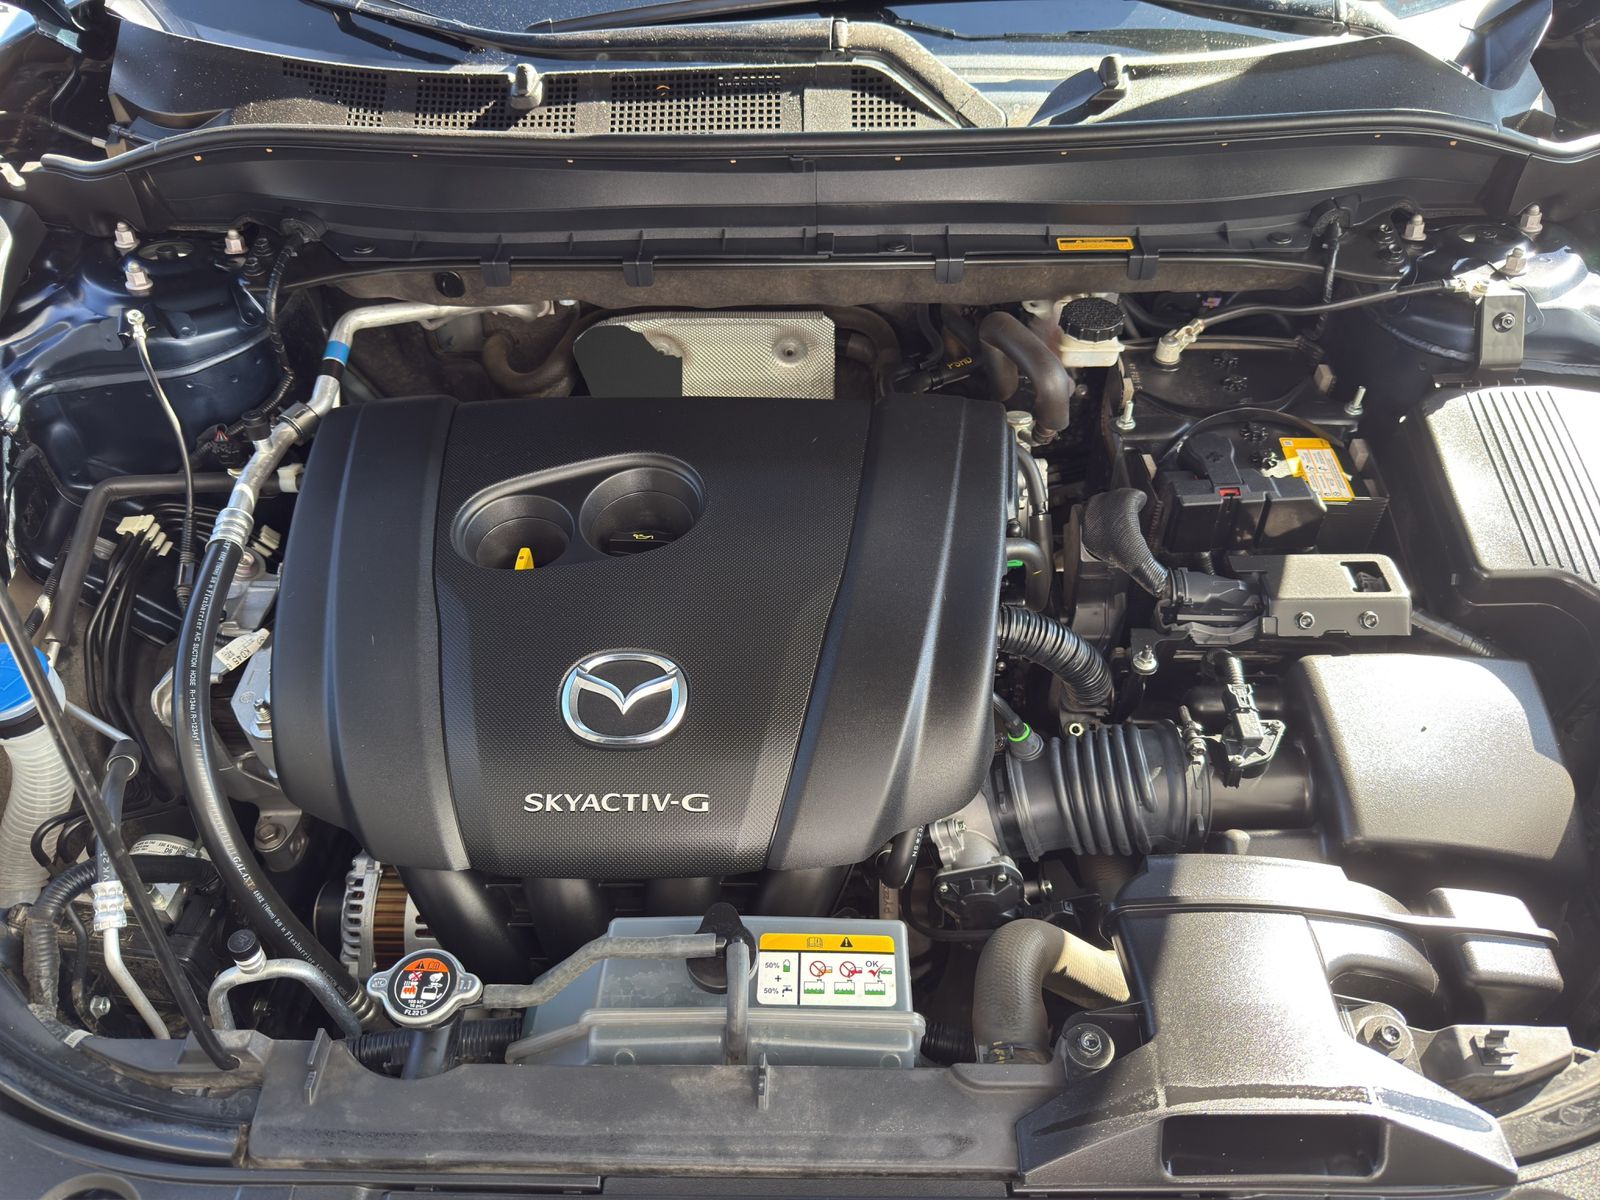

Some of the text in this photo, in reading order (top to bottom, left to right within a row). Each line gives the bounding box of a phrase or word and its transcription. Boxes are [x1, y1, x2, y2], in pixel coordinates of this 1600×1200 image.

[191, 643, 199, 668] SUCTION
[189, 670, 197, 686] HOSE
[523, 792, 710, 813] SKYACTIV-G
[284, 930, 316, 966] Flexbarrier
[865, 960, 879, 968] OK
[404, 1008, 420, 1016] FL22
